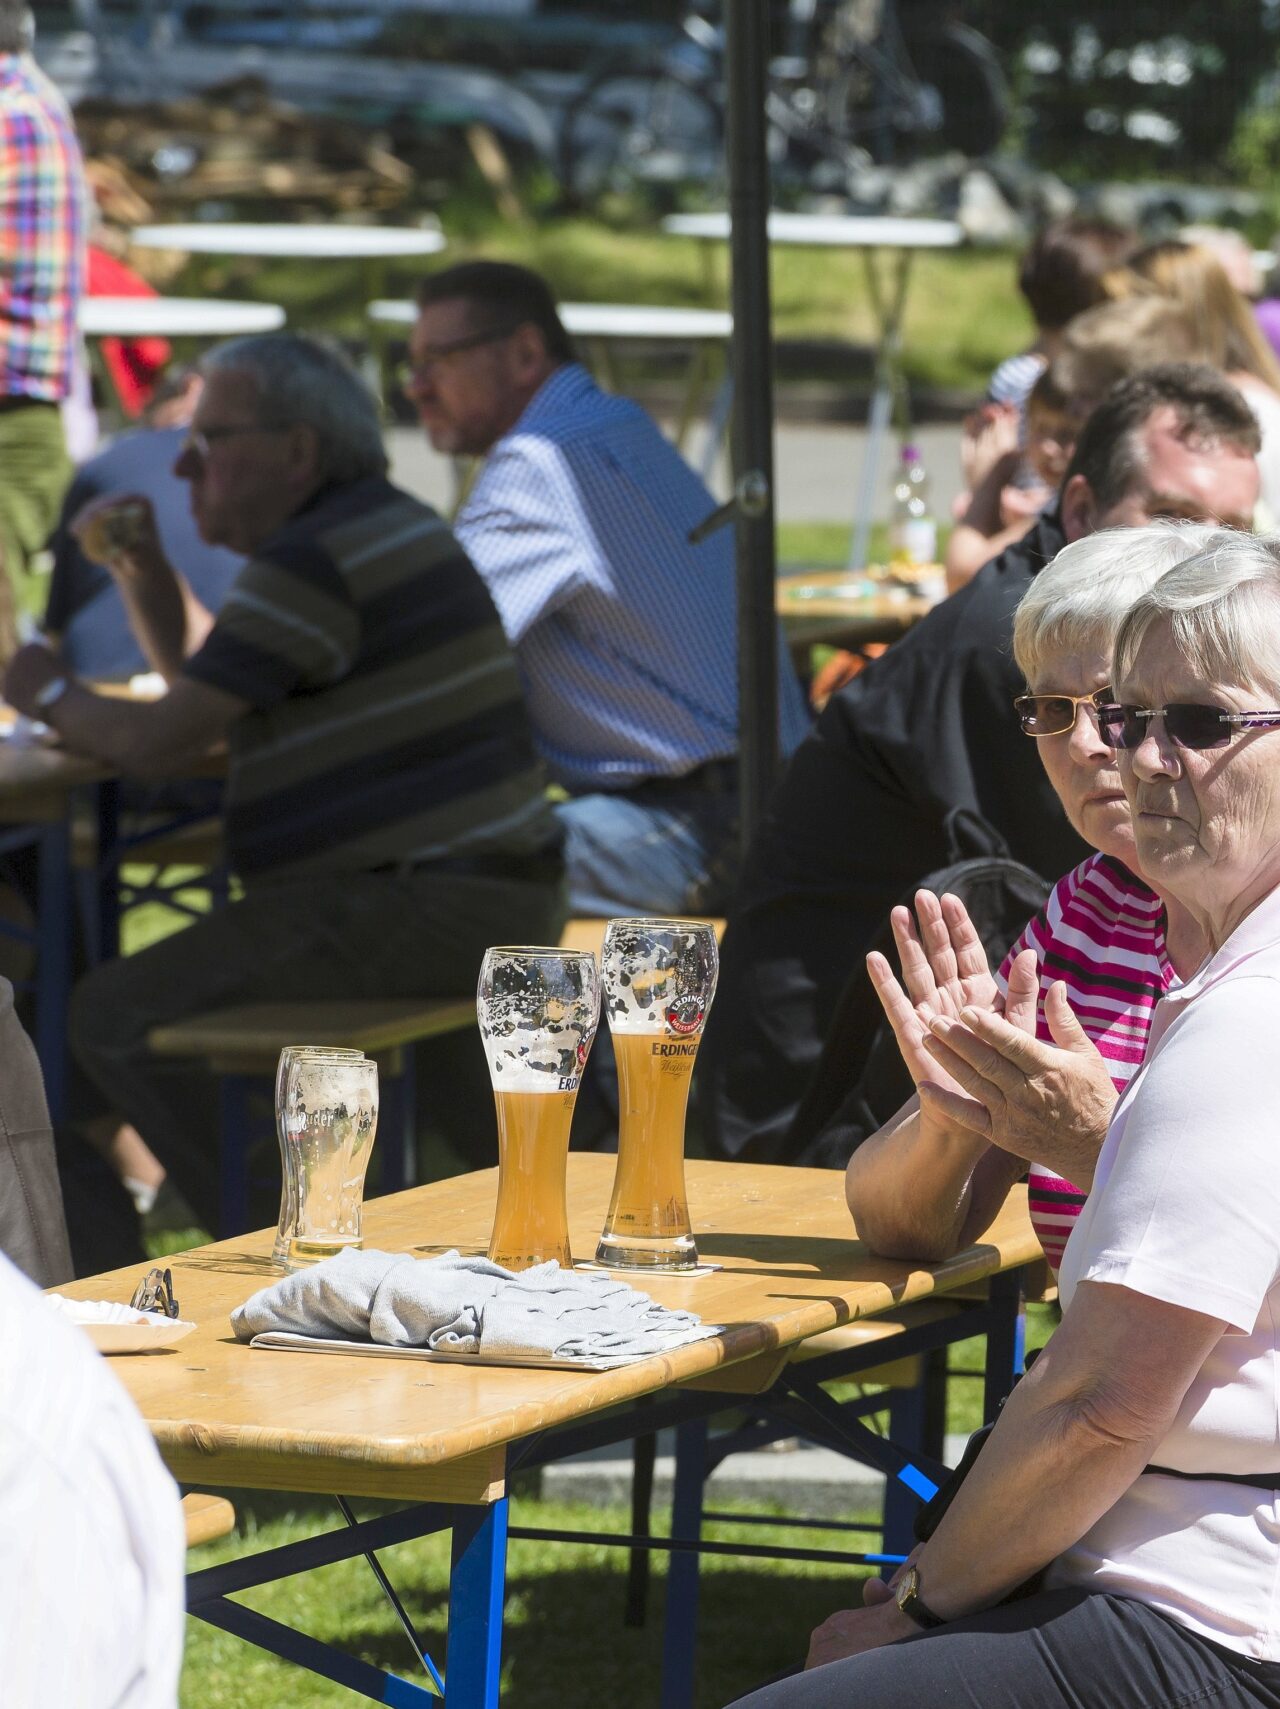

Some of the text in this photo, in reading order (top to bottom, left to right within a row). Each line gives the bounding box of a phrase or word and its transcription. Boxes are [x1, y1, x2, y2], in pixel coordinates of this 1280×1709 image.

[671, 994, 705, 1011] ERDINGER
[652, 1042, 698, 1057] ERDINGE
[558, 1077, 579, 1091] ERD
